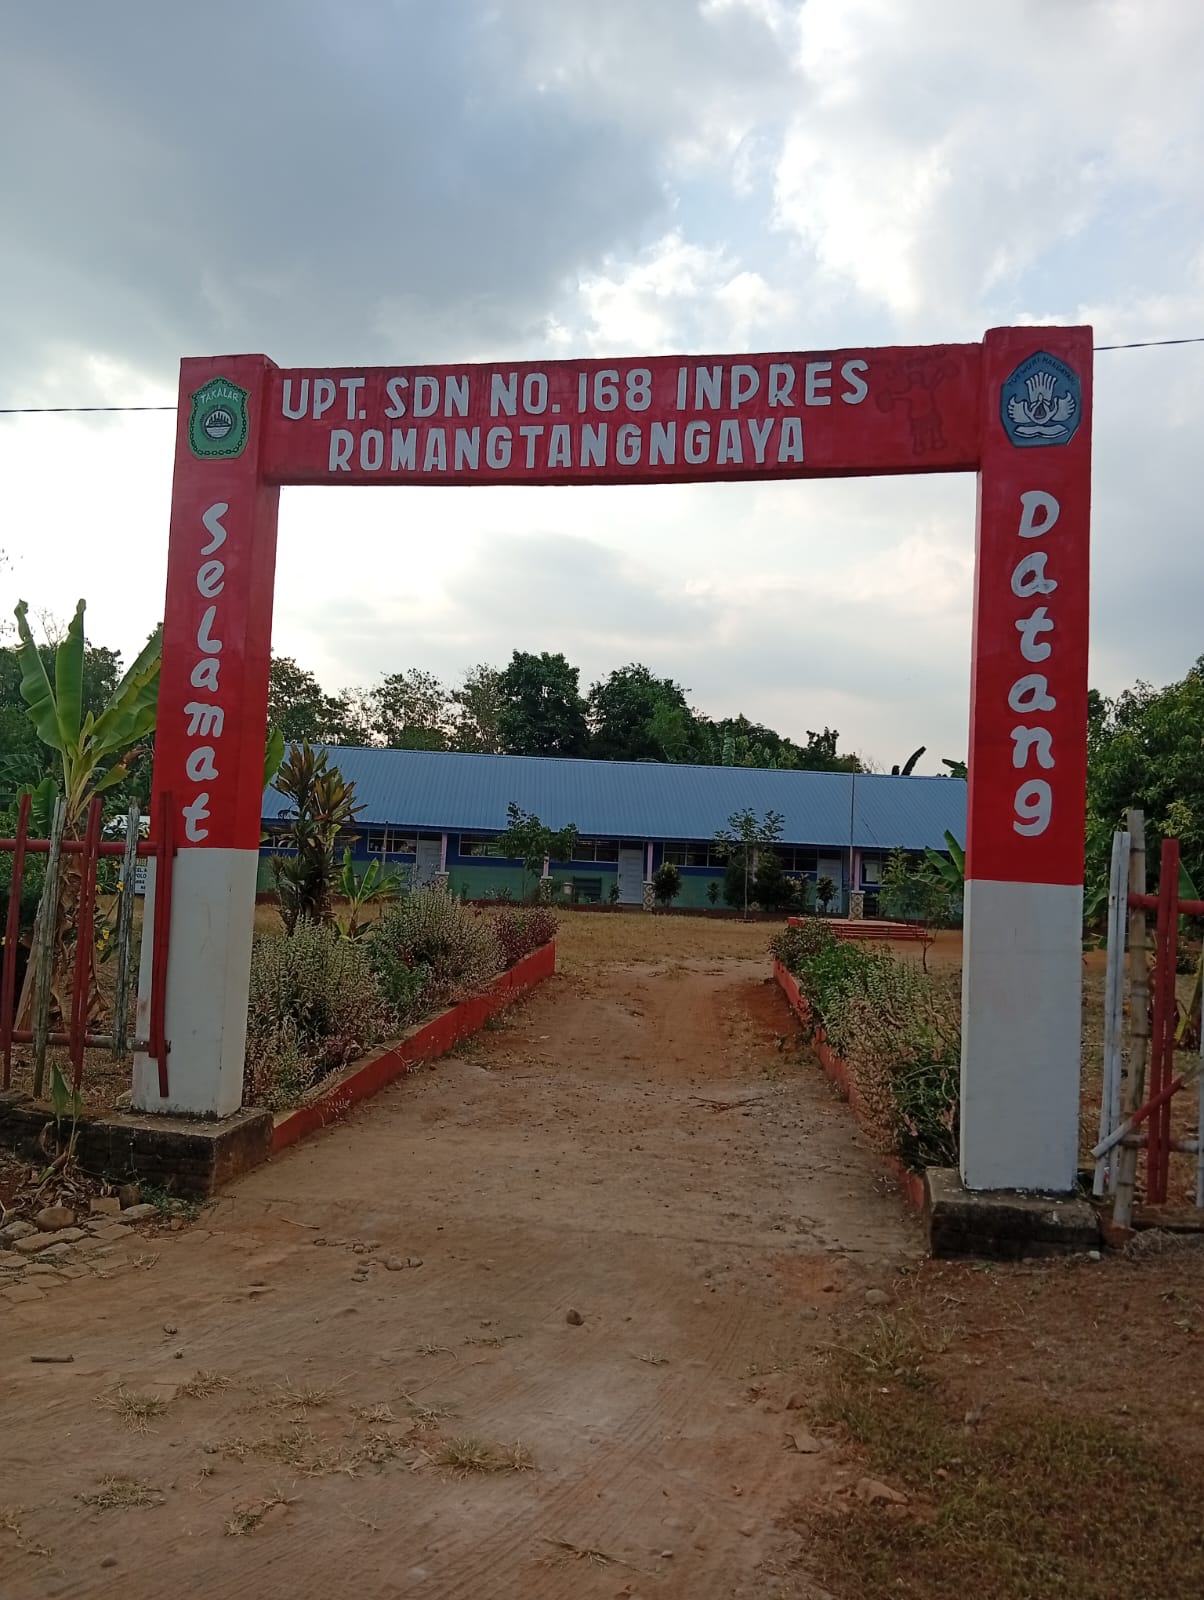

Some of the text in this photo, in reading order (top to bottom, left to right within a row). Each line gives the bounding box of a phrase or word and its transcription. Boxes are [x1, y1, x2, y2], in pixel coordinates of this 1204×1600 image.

[201, 387, 239, 404] TAKALAR
[282, 360, 869, 420] UPT. SDN NO. 168 INPRES
[328, 416, 804, 473] ROMANGTANGNGAYA
[182, 501, 230, 843] Selamat
[1007, 489, 1060, 837] Datang
